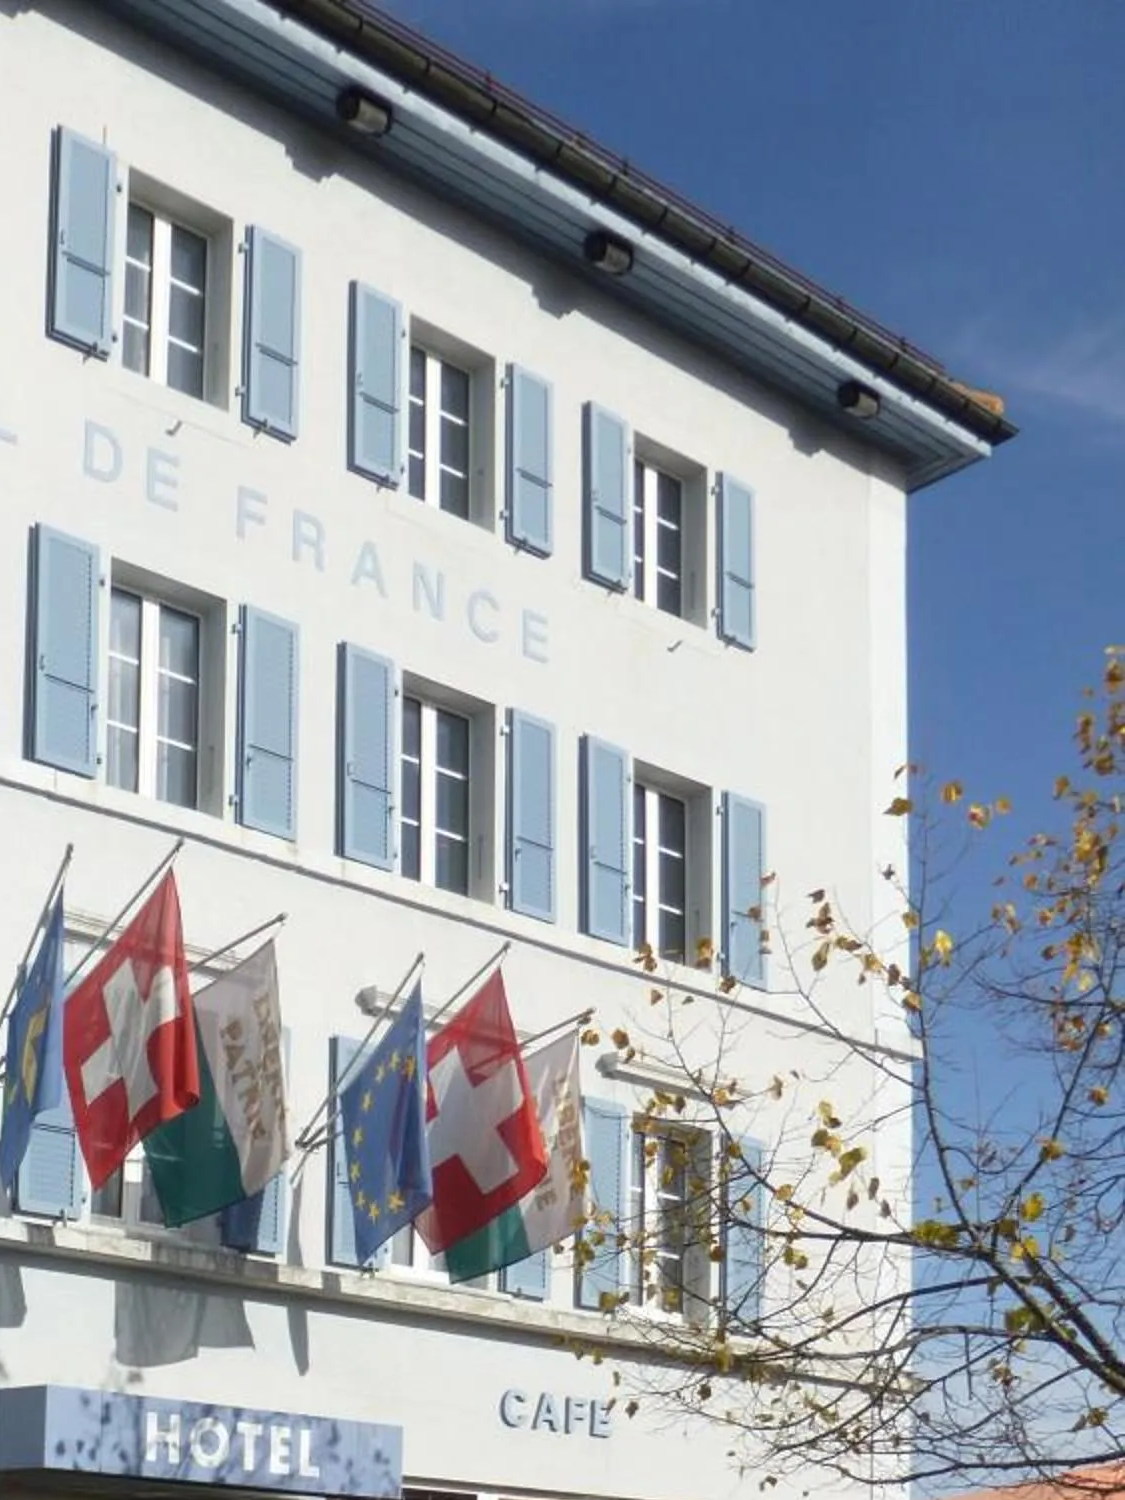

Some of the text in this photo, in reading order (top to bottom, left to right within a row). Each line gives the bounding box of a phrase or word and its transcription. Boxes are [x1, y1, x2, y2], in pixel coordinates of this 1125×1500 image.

[83, 419, 182, 512] DE
[235, 484, 552, 664] FRANCE
[145, 1411, 320, 1479] HOTEL
[499, 1388, 612, 1438] CAFE
